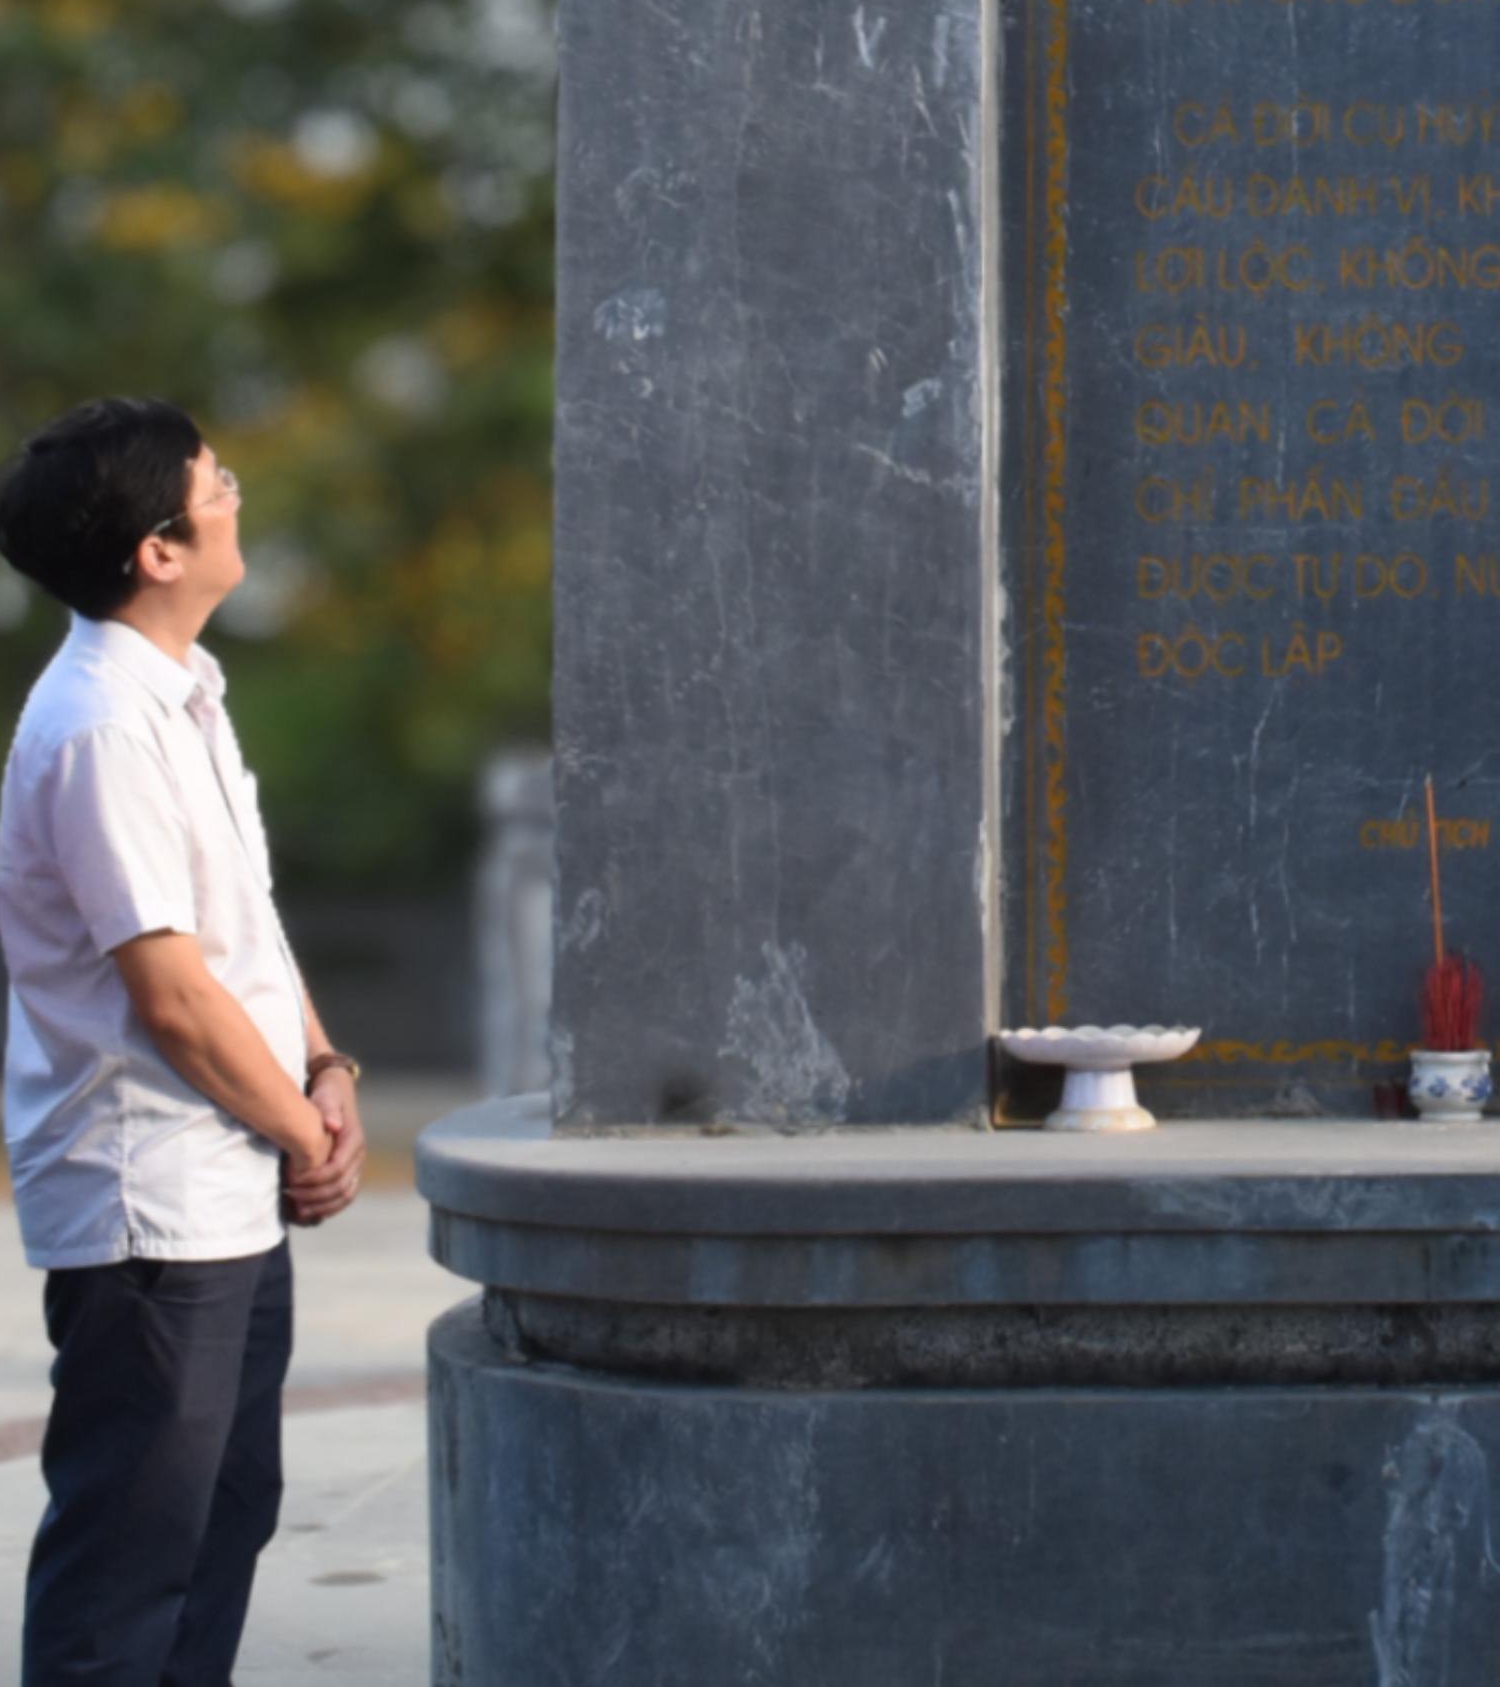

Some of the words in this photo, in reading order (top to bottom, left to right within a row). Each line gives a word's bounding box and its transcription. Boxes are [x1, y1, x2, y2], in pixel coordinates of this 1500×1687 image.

[1174, 94, 1240, 146] CẢ
[1252, 92, 1331, 146] ĐỜI
[1343, 99, 1405, 149] CỤ
[1248, 174, 1377, 216] DANH
[1135, 246, 1205, 299] LỢI
[1306, 388, 1376, 445] CẢ
[1400, 390, 1484, 445] ĐỜI
[1135, 467, 1211, 524] CHỈ
[1240, 463, 1363, 520] PHẤN
[1137, 553, 1274, 606] ĐƯỢC
[1293, 553, 1342, 607] TỰ
[1136, 622, 1245, 685] ĐỘC
